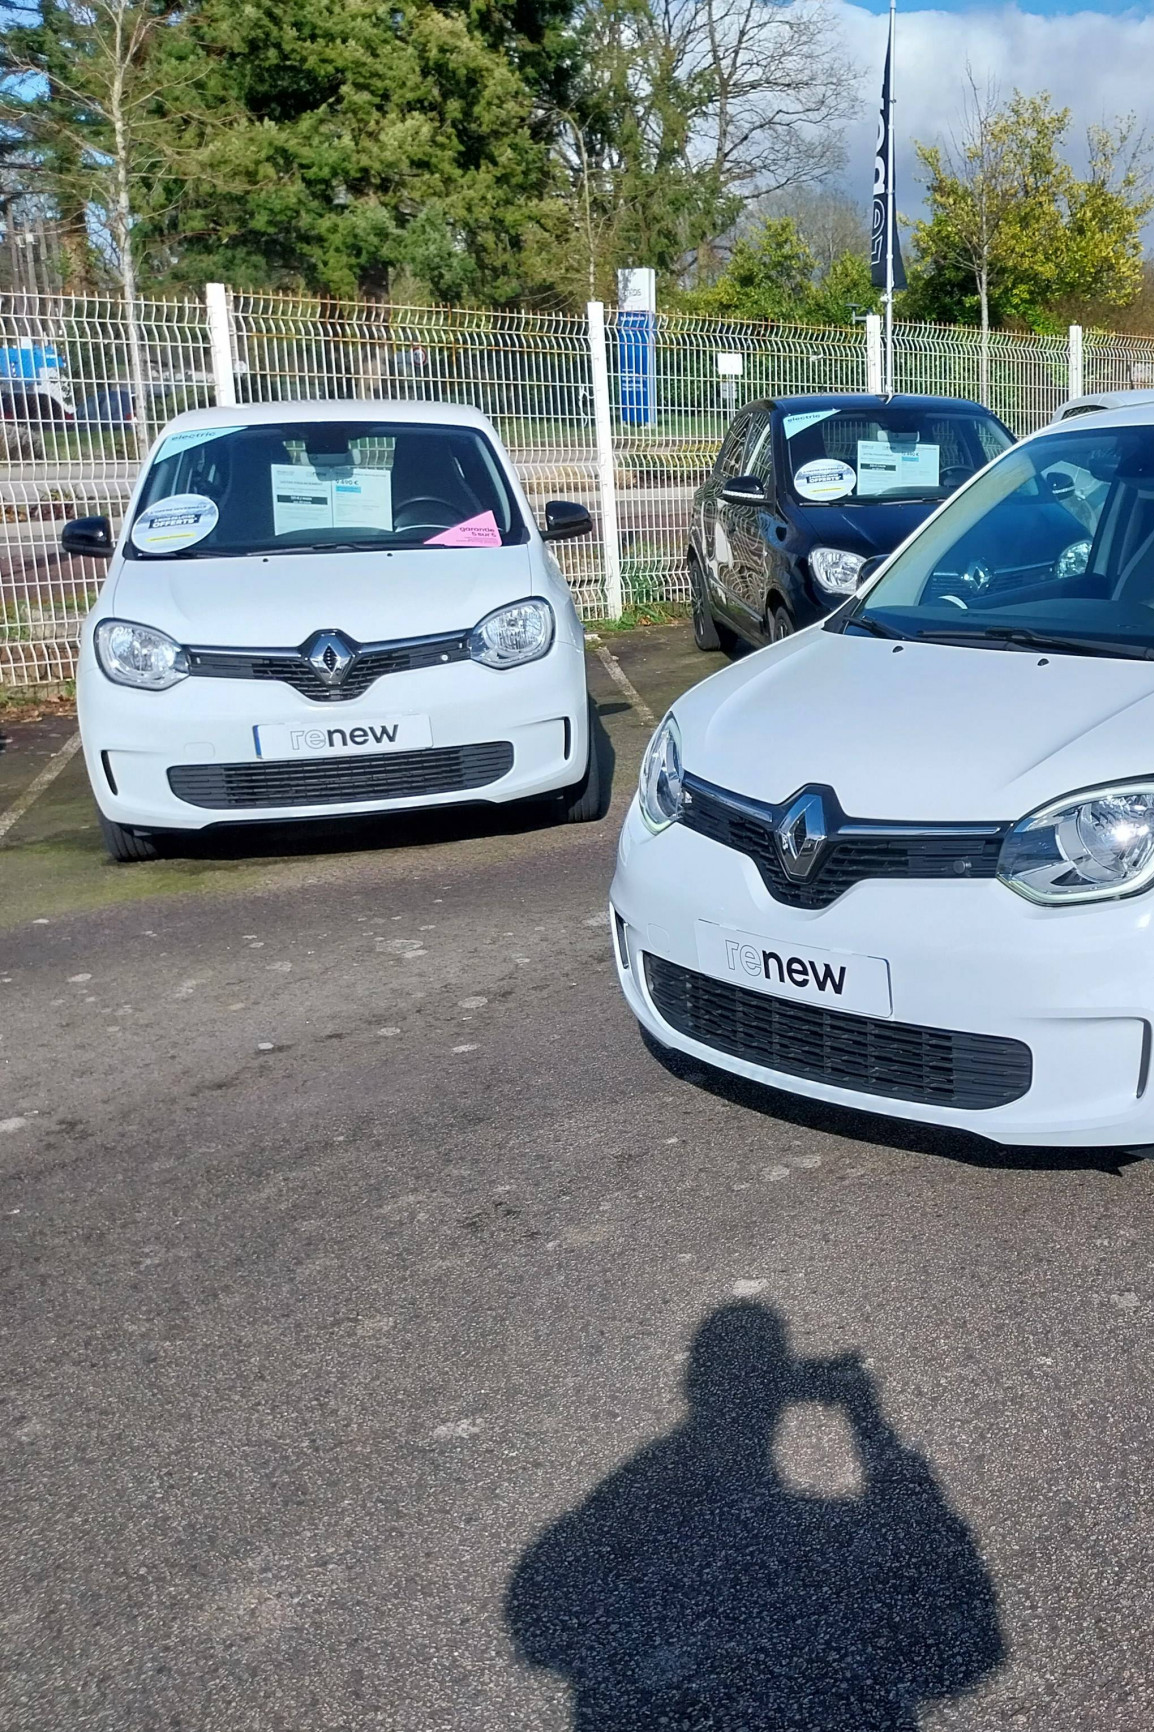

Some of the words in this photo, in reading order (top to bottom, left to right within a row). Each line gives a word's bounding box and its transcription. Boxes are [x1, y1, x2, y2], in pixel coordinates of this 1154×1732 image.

[787, 414, 821, 422] electric
[171, 431, 217, 441] electric
[290, 723, 399, 751] renew
[725, 939, 846, 995] renew
